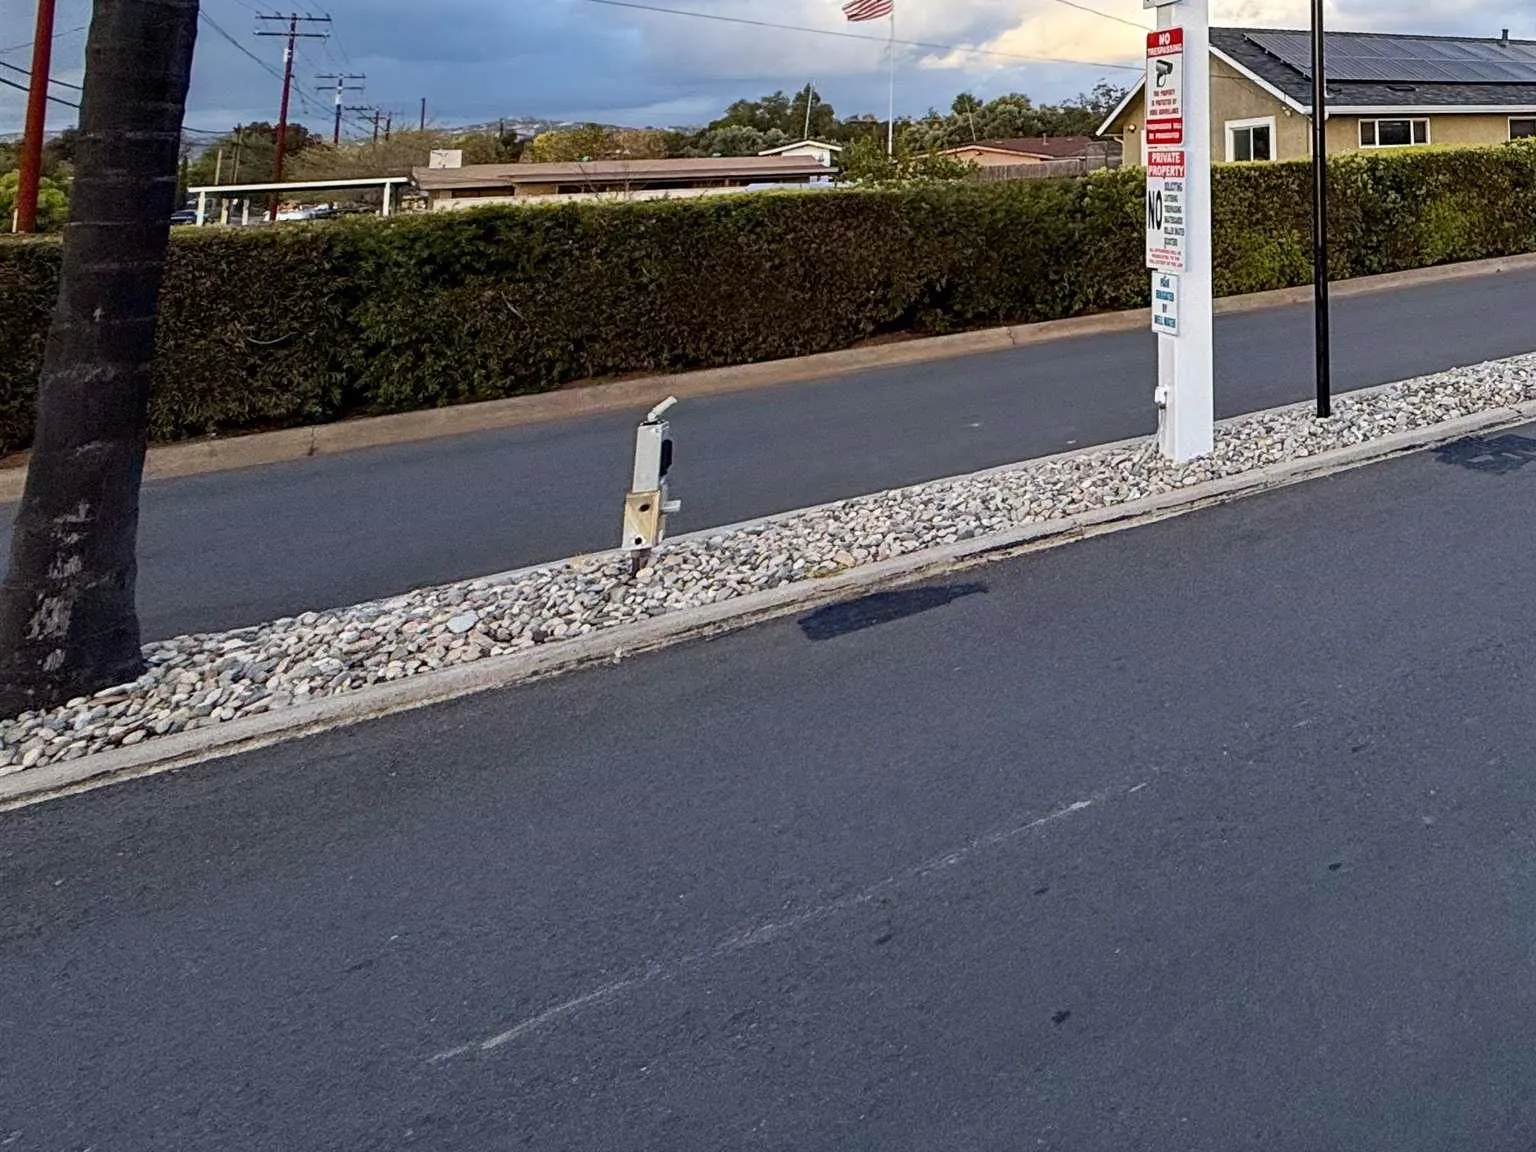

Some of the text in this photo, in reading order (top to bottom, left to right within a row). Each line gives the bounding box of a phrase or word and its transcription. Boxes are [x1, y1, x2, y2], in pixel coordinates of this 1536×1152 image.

[1158, 32, 1171, 45] NO
[1151, 152, 1181, 164] PRIVATE
[1148, 165, 1184, 177] PROPERTY
[1148, 190, 1163, 230] NO
